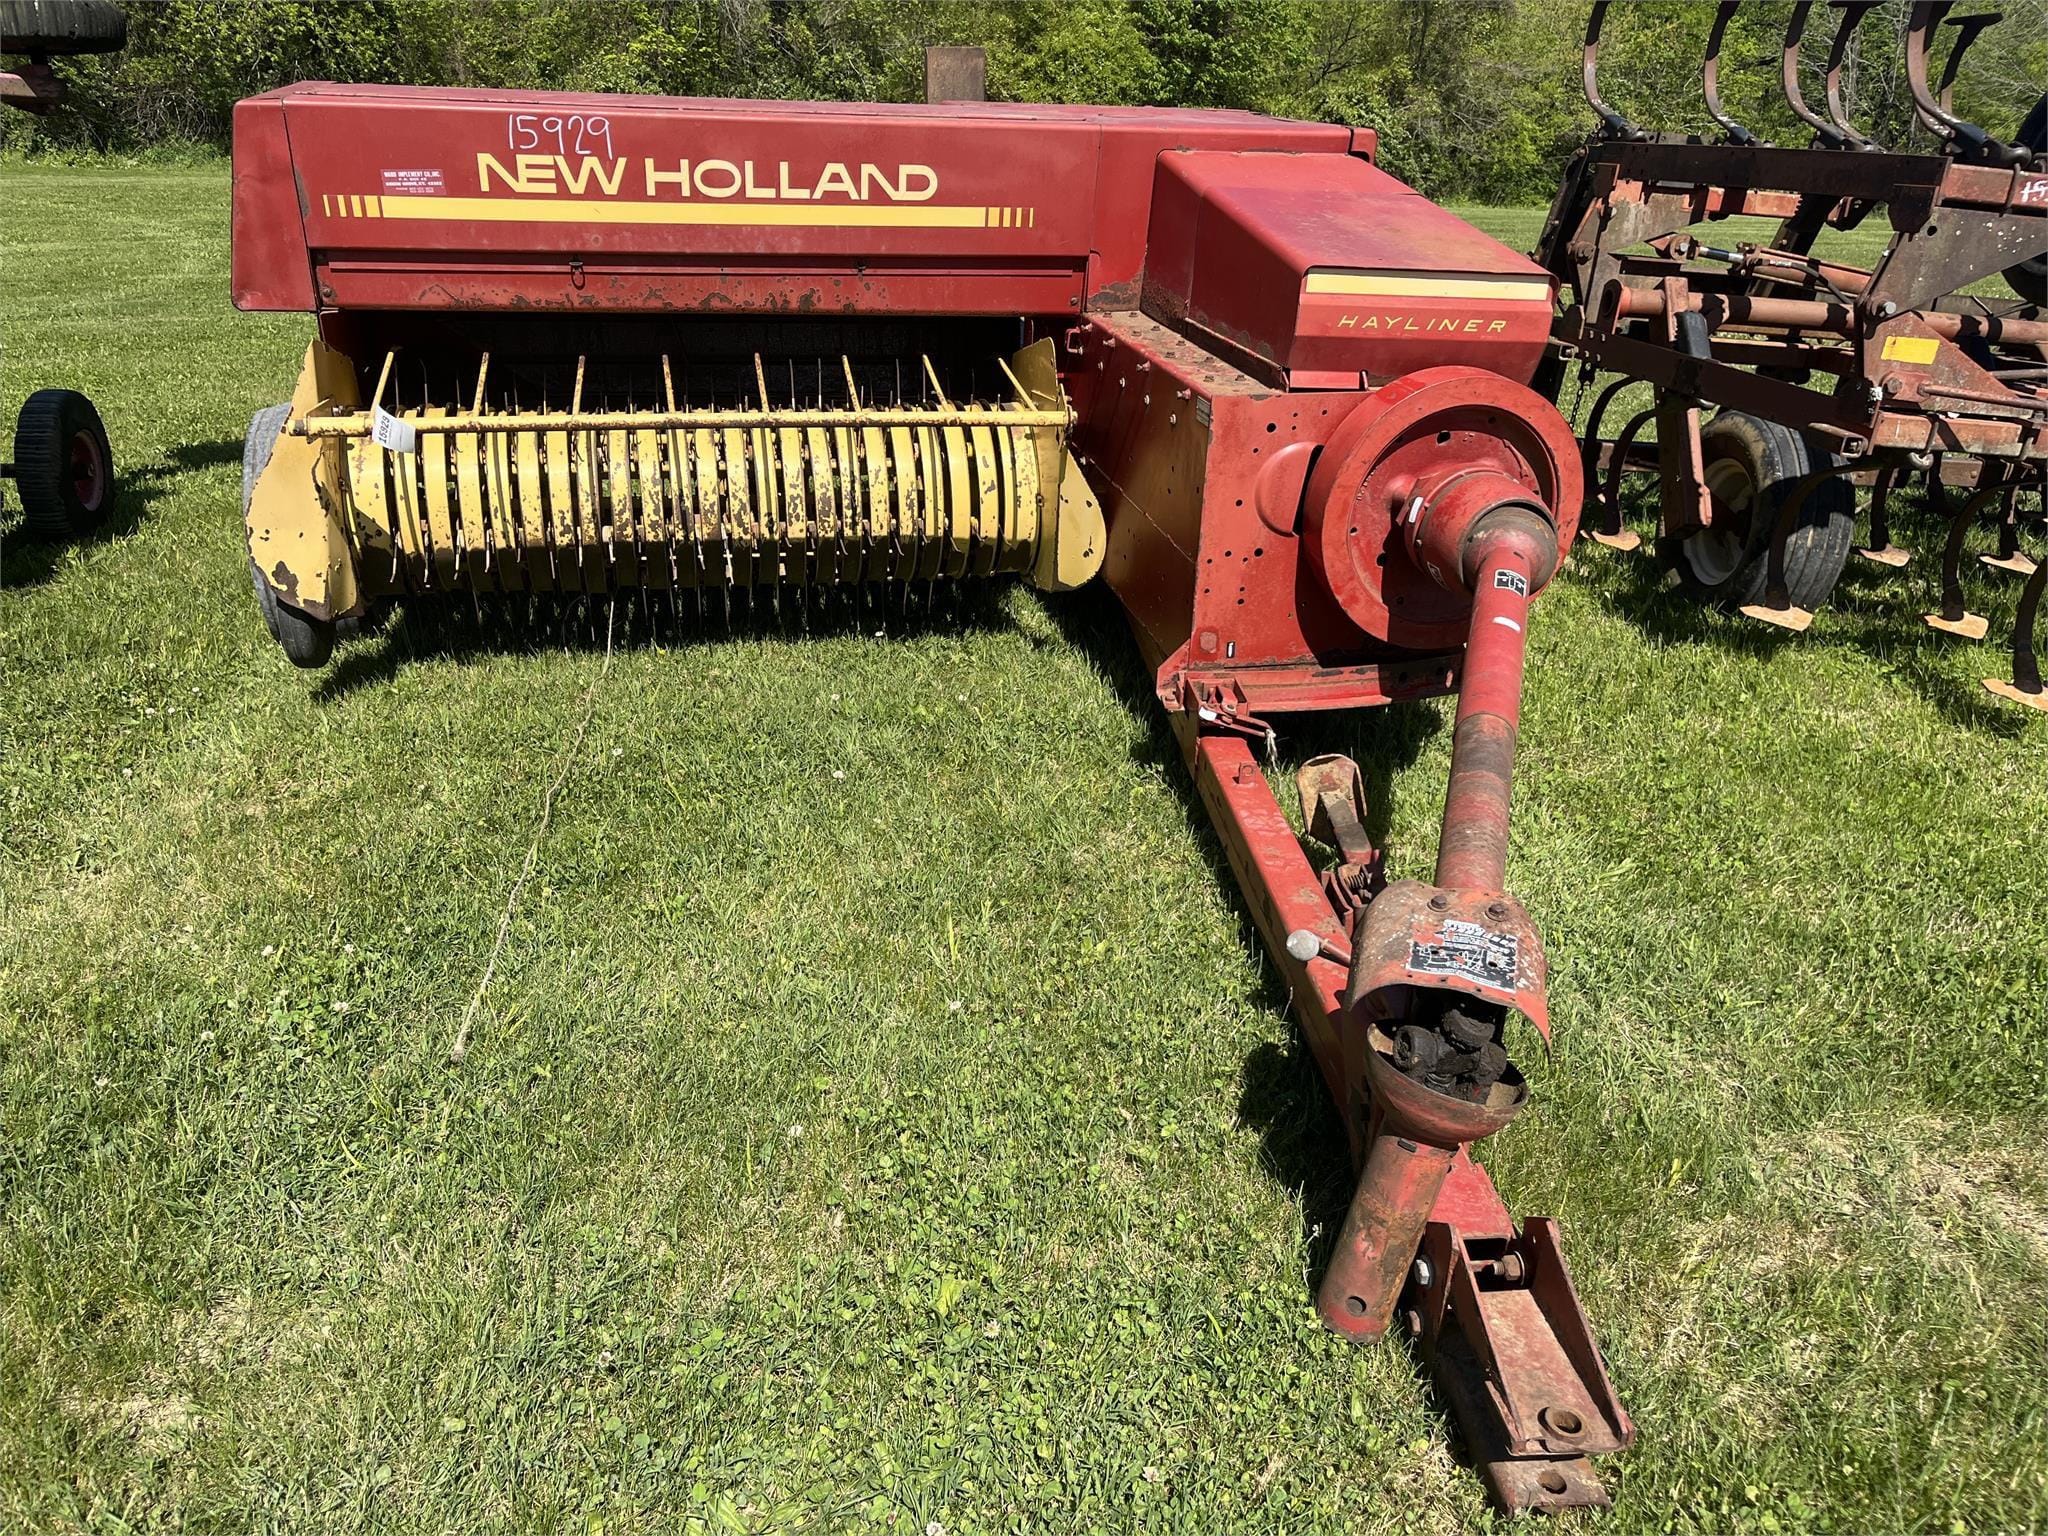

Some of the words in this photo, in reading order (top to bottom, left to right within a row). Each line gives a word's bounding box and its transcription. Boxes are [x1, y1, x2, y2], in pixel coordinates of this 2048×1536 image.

[508, 114, 613, 160] 15929
[476, 152, 627, 196] NEW
[644, 157, 938, 201] HOLLAND
[1337, 315, 1507, 333] HAYLINER
[378, 415, 390, 444] 15929
